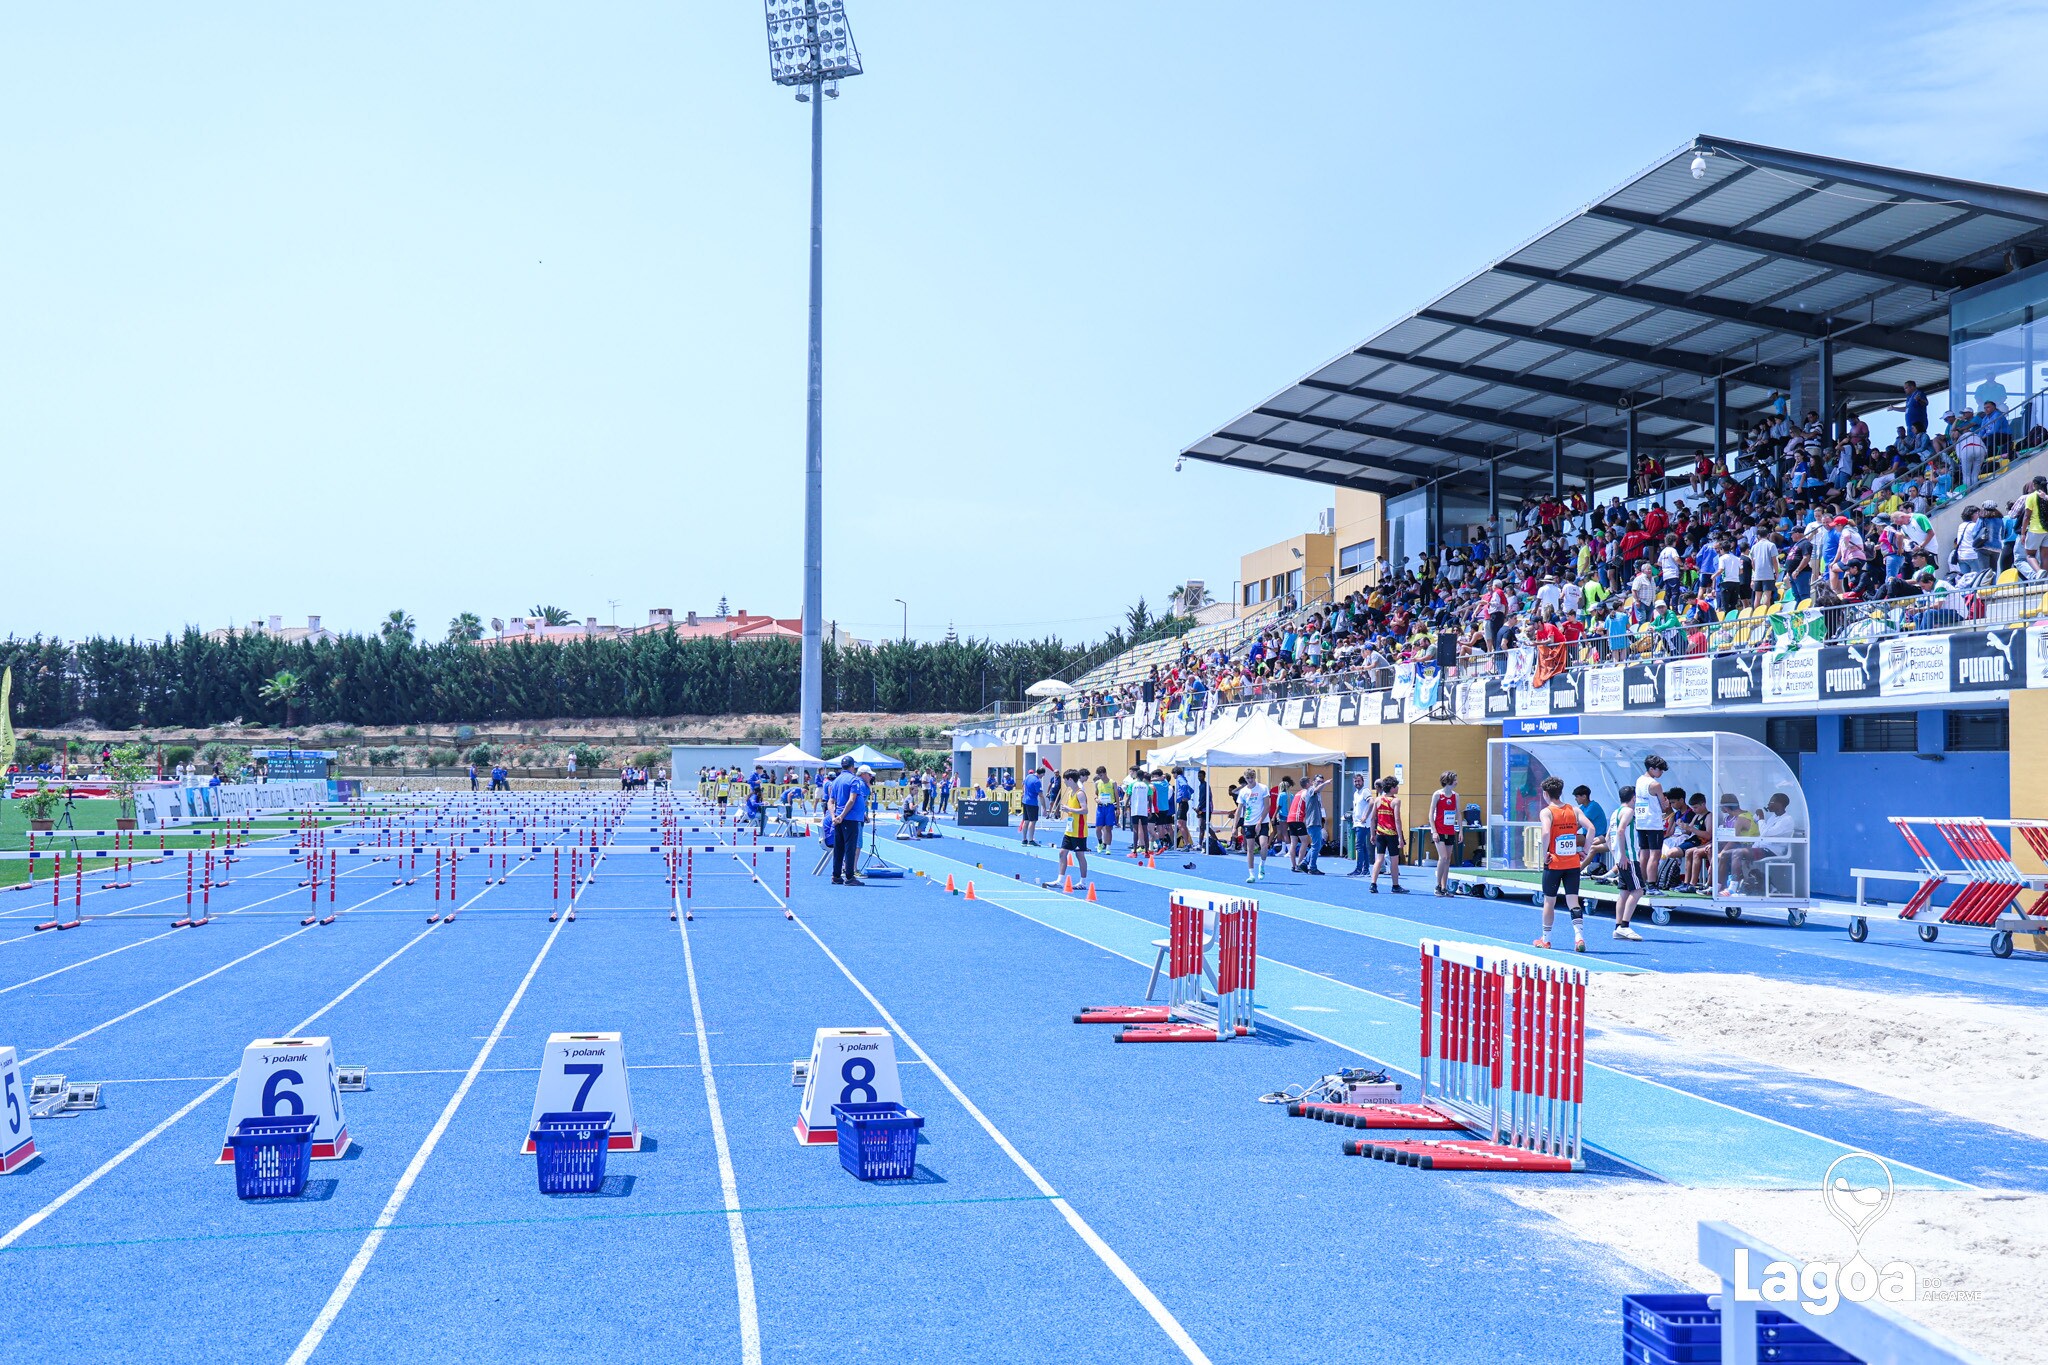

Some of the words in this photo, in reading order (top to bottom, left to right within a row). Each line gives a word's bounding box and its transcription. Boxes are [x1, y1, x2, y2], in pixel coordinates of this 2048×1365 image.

[1910, 645, 1944, 657] FEDERAÇÃO
[1910, 659, 1944, 669] PORTUGUESA
[1959, 656, 2005, 683] PUMA
[1826, 667, 1863, 692] PUMA
[1910, 671, 1944, 682] ATLETISMO
[1628, 683, 1654, 704] PUMA
[1718, 676, 1749, 699] PUMA
[1786, 681, 1813, 691] ATLETISMO
[1521, 721, 1535, 733] Lagoa
[1539, 720, 1558, 733] Algarve
[572, 1048, 606, 1058] polanik
[847, 1042, 879, 1052] polanik
[272, 1053, 308, 1064] polanik
[564, 1063, 603, 1112] 7
[840, 1057, 878, 1103] 8
[262, 1069, 304, 1116] 6
[4, 1072, 21, 1135] 5
[576, 1130, 591, 1140] 19
[1639, 1309, 1656, 1330] 121
